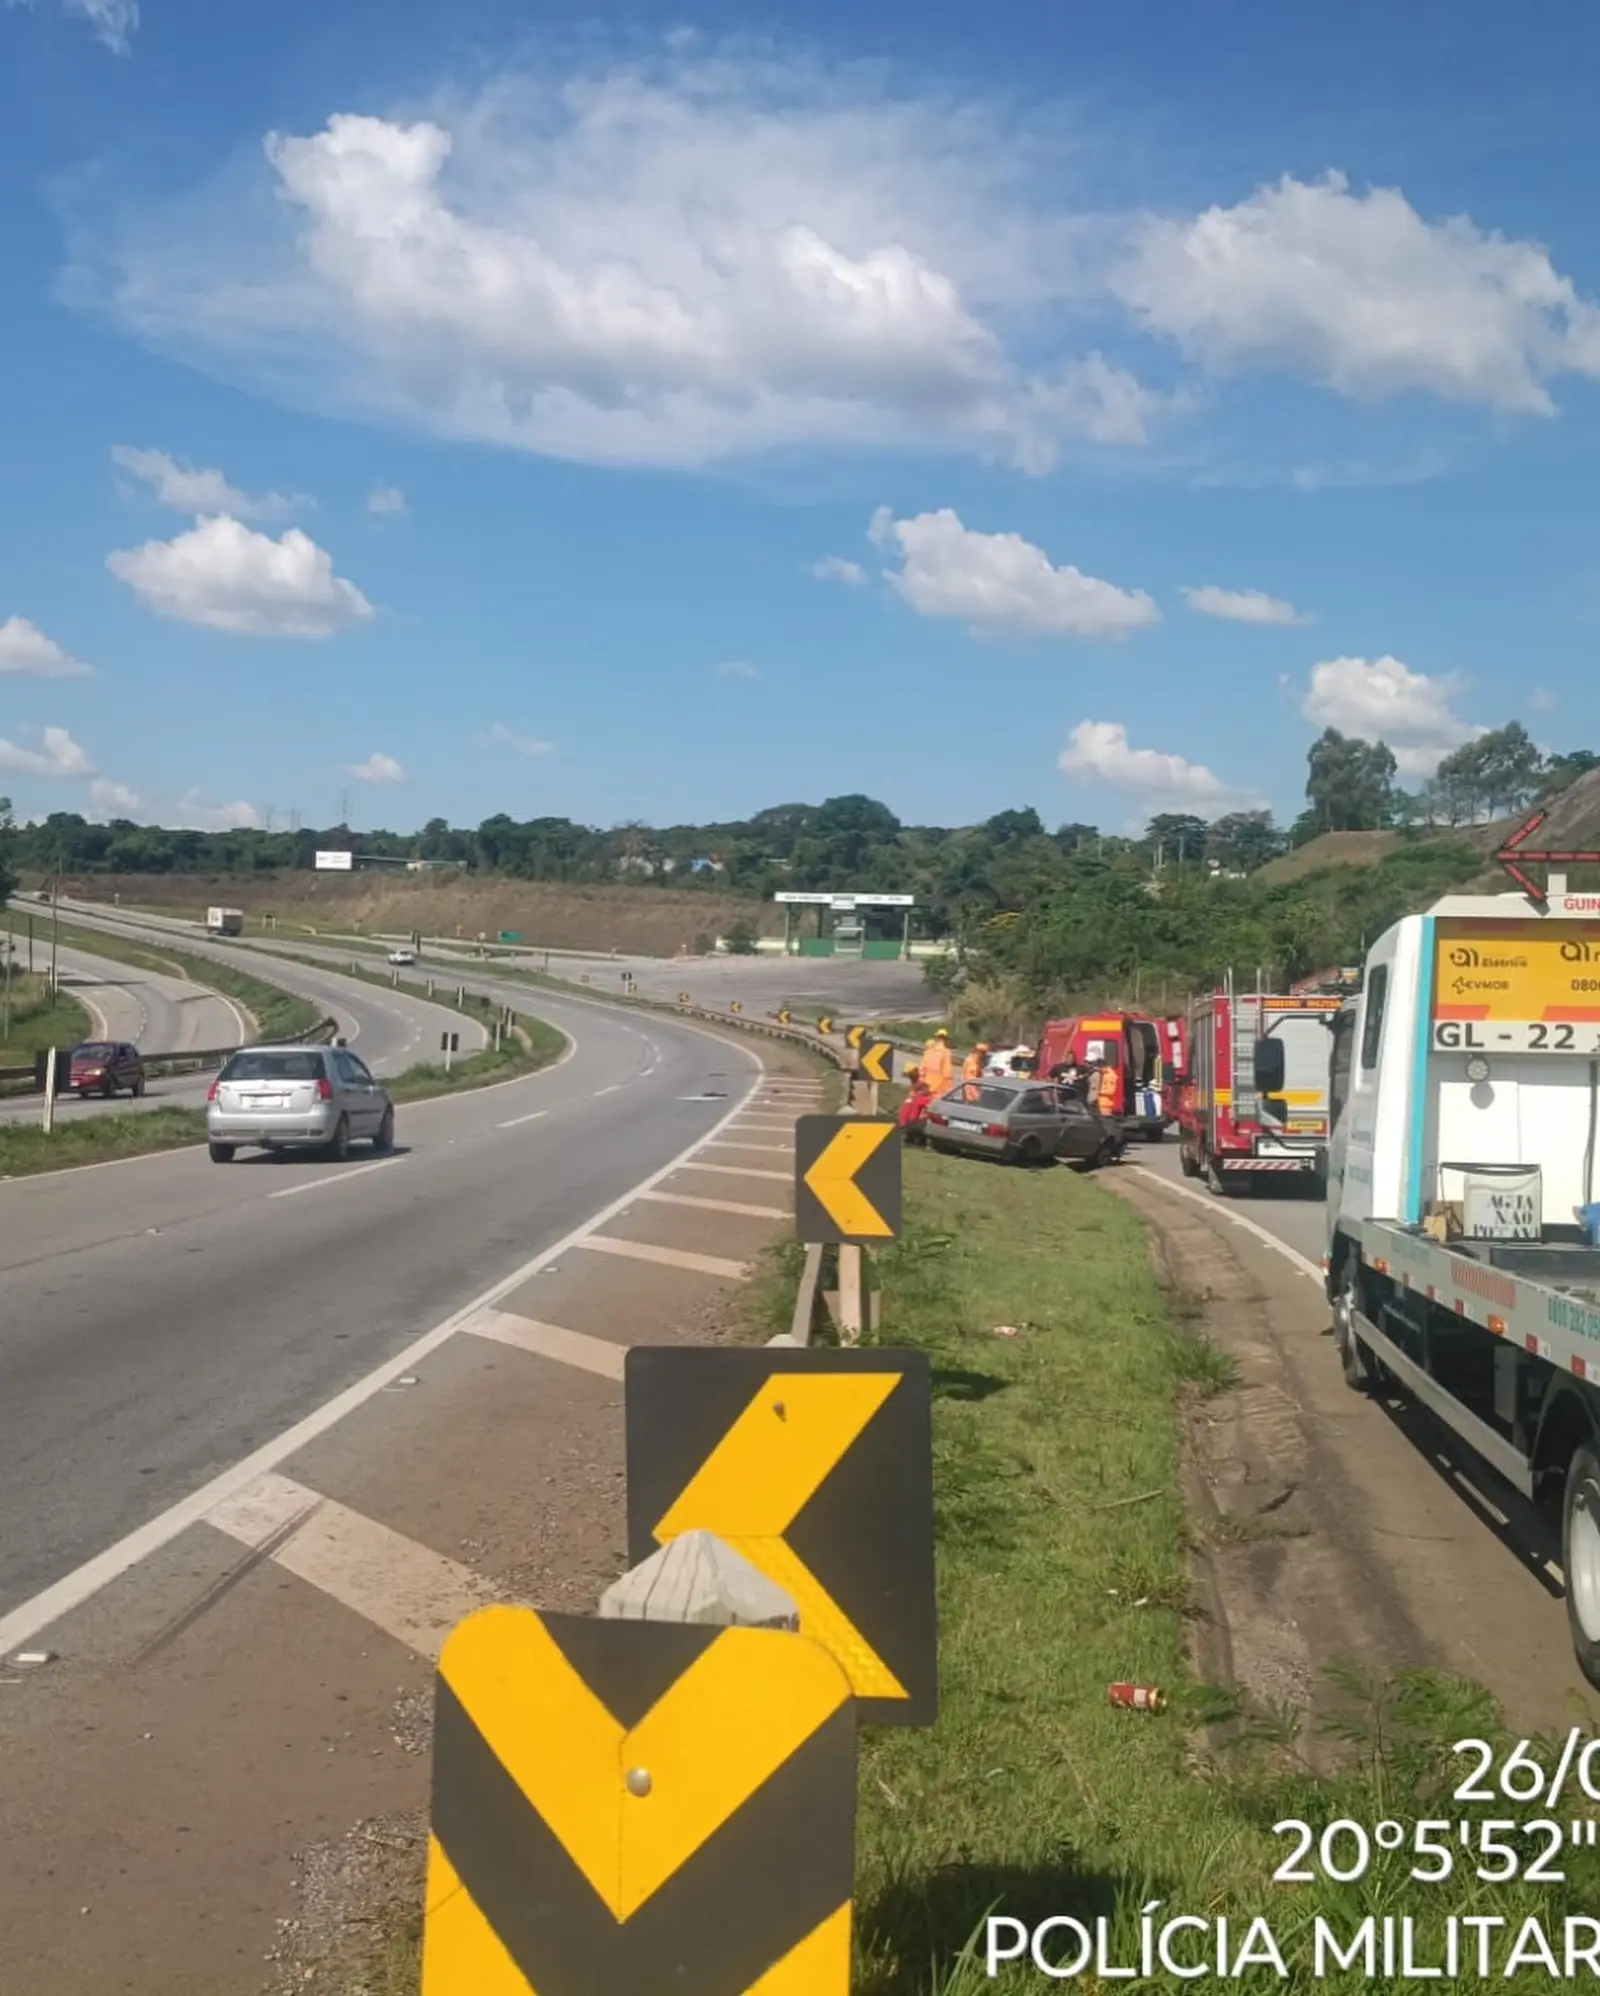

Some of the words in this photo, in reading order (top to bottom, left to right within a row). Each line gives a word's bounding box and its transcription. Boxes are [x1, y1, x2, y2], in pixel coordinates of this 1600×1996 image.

[1571, 978, 1600, 992] 080
[1436, 1022, 1485, 1048] GL
[1528, 1023, 1575, 1049] 22
